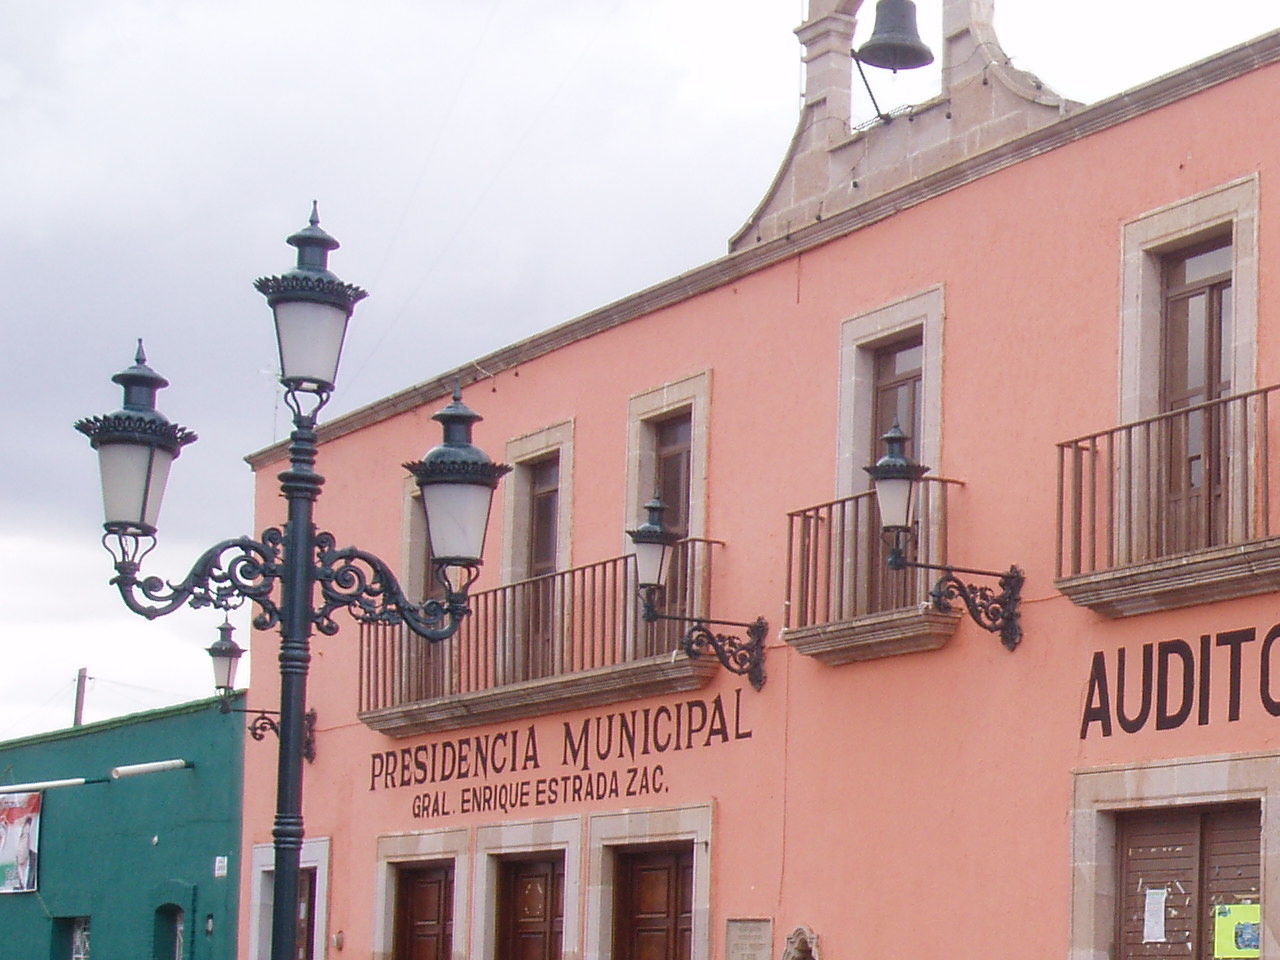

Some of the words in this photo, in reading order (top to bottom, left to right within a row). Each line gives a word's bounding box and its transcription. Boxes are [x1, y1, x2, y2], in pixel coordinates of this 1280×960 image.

[370, 724, 540, 791] PRESIDENCIA
[561, 688, 752, 771] MUNICIPAL
[412, 794, 456, 819] GRAL.
[461, 780, 531, 814] ENRIQUE
[535, 769, 619, 806] ESTRADA
[626, 764, 669, 797] ZAC.
